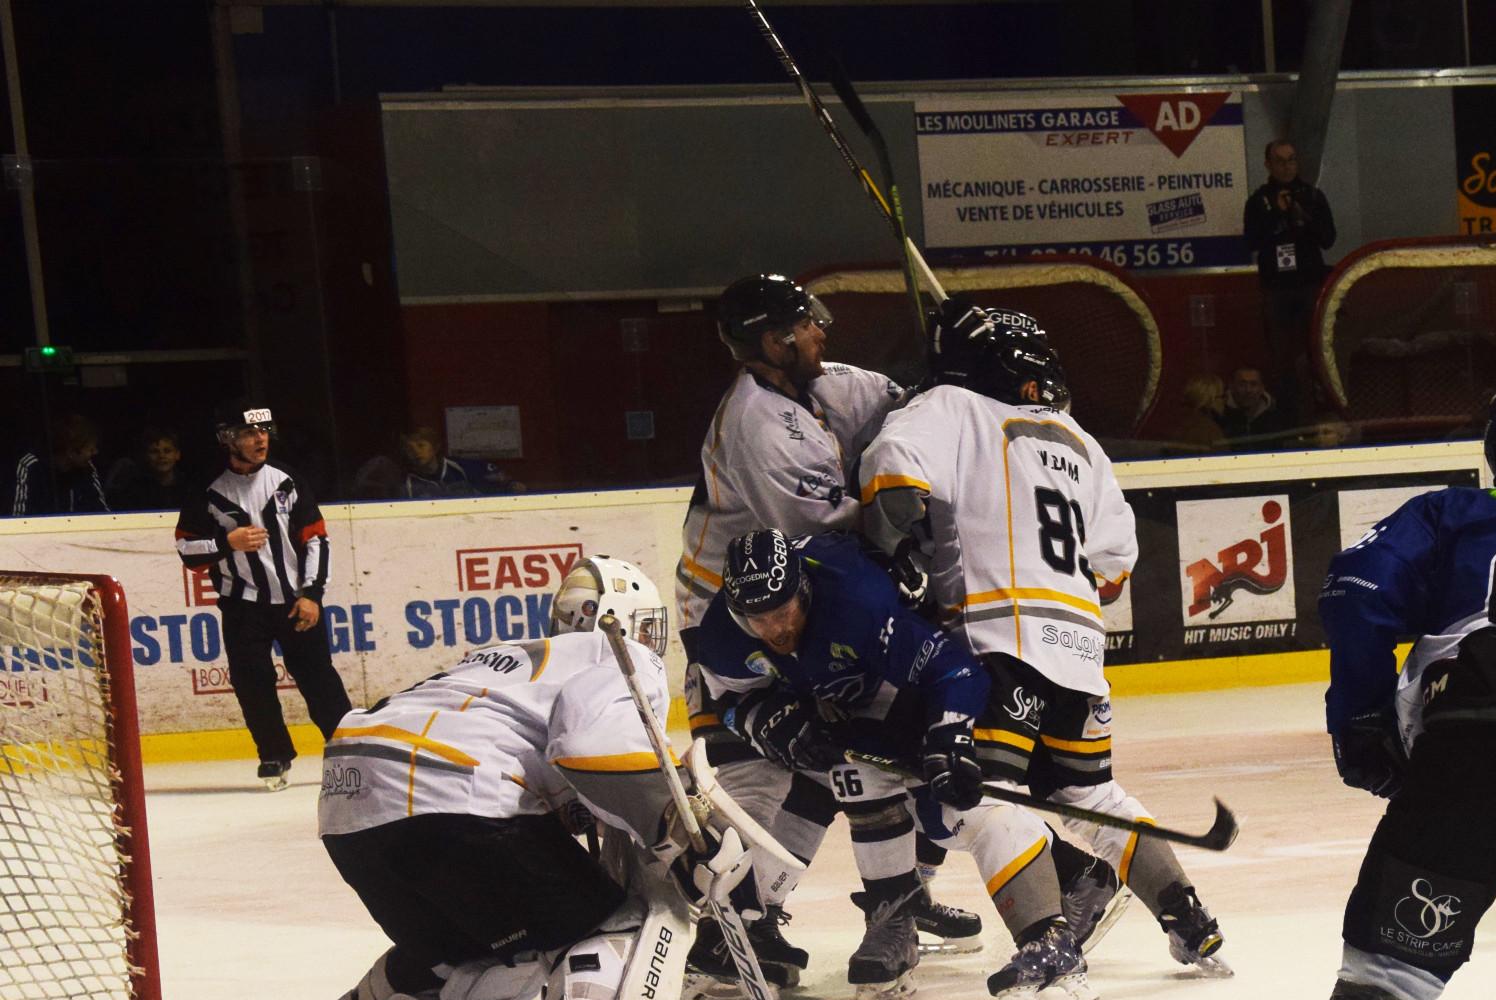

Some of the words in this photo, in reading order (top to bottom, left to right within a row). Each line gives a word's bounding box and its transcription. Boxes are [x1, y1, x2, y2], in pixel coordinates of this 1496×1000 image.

[916, 115, 942, 132] LES
[946, 112, 1036, 131] MOULINETS
[1041, 110, 1120, 128] GARAGE
[1155, 101, 1201, 131] AD
[1045, 131, 1134, 147] EXPERT
[927, 178, 1026, 198] MÉCANIQUE
[1038, 175, 1146, 195] CARROSSERIE
[1157, 172, 1234, 190] PEINTURE
[956, 205, 1010, 223] VENTE
[1012, 203, 1034, 221] DE
[1036, 200, 1125, 220] VÉHICULES
[1133, 244, 1161, 266] 56
[1166, 243, 1195, 265] 56
[465, 552, 577, 592] EASY
[1184, 629, 1206, 645] HIT
[1255, 624, 1288, 640] ONLY
[760, 699, 800, 739] CCM
[832, 768, 864, 798] 56
[1380, 926, 1396, 940] LE
[1396, 930, 1430, 950] STRIP
